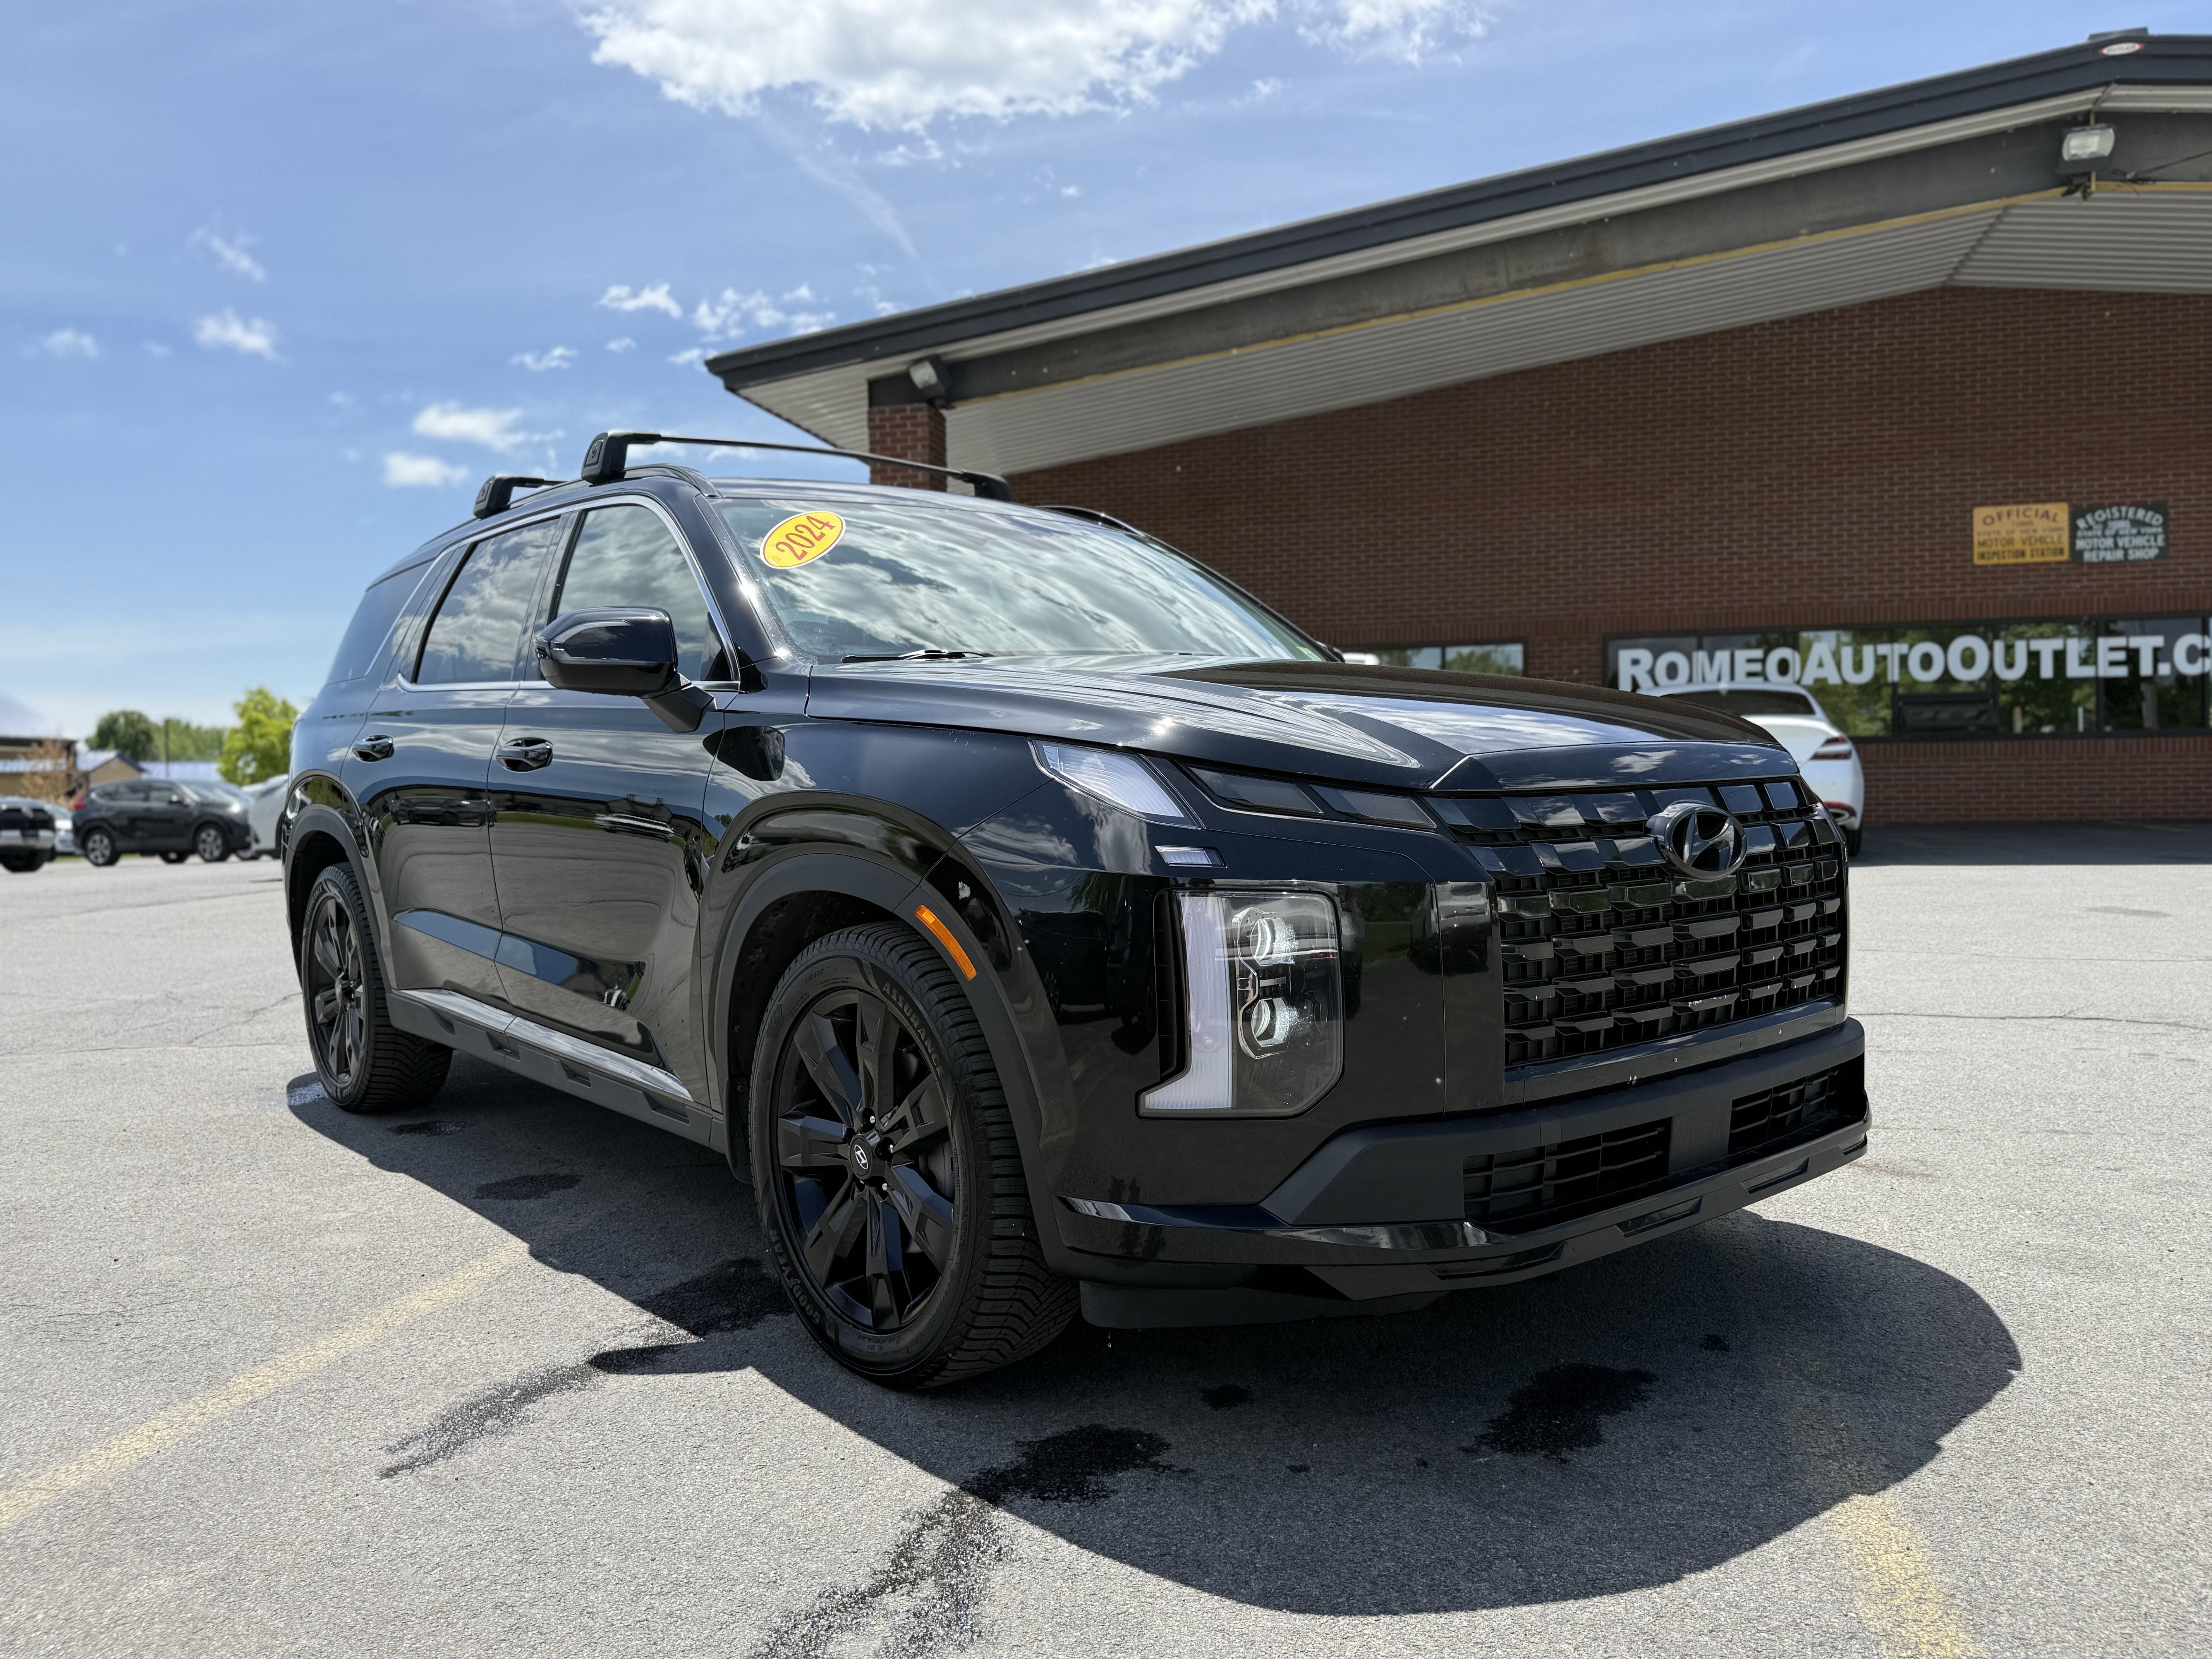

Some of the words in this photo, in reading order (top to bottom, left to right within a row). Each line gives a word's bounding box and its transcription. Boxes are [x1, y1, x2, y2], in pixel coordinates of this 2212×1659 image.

[1982, 508, 2057, 526] OFFICIAL
[2076, 506, 2163, 530] REGISTERED
[775, 516, 835, 560] 2024
[1977, 537, 2015, 548] MOTOR
[2020, 534, 2064, 546] VEHICLE
[2075, 537, 2115, 551] MOTOR
[2116, 534, 2165, 549] VEHICLE
[1977, 549, 2026, 561] INSPECTION
[2030, 547, 2064, 558] STATION
[2083, 548, 2125, 563] REPAIR
[2127, 547, 2160, 561] SHOP
[882, 982, 945, 1078] ASSURANCE
